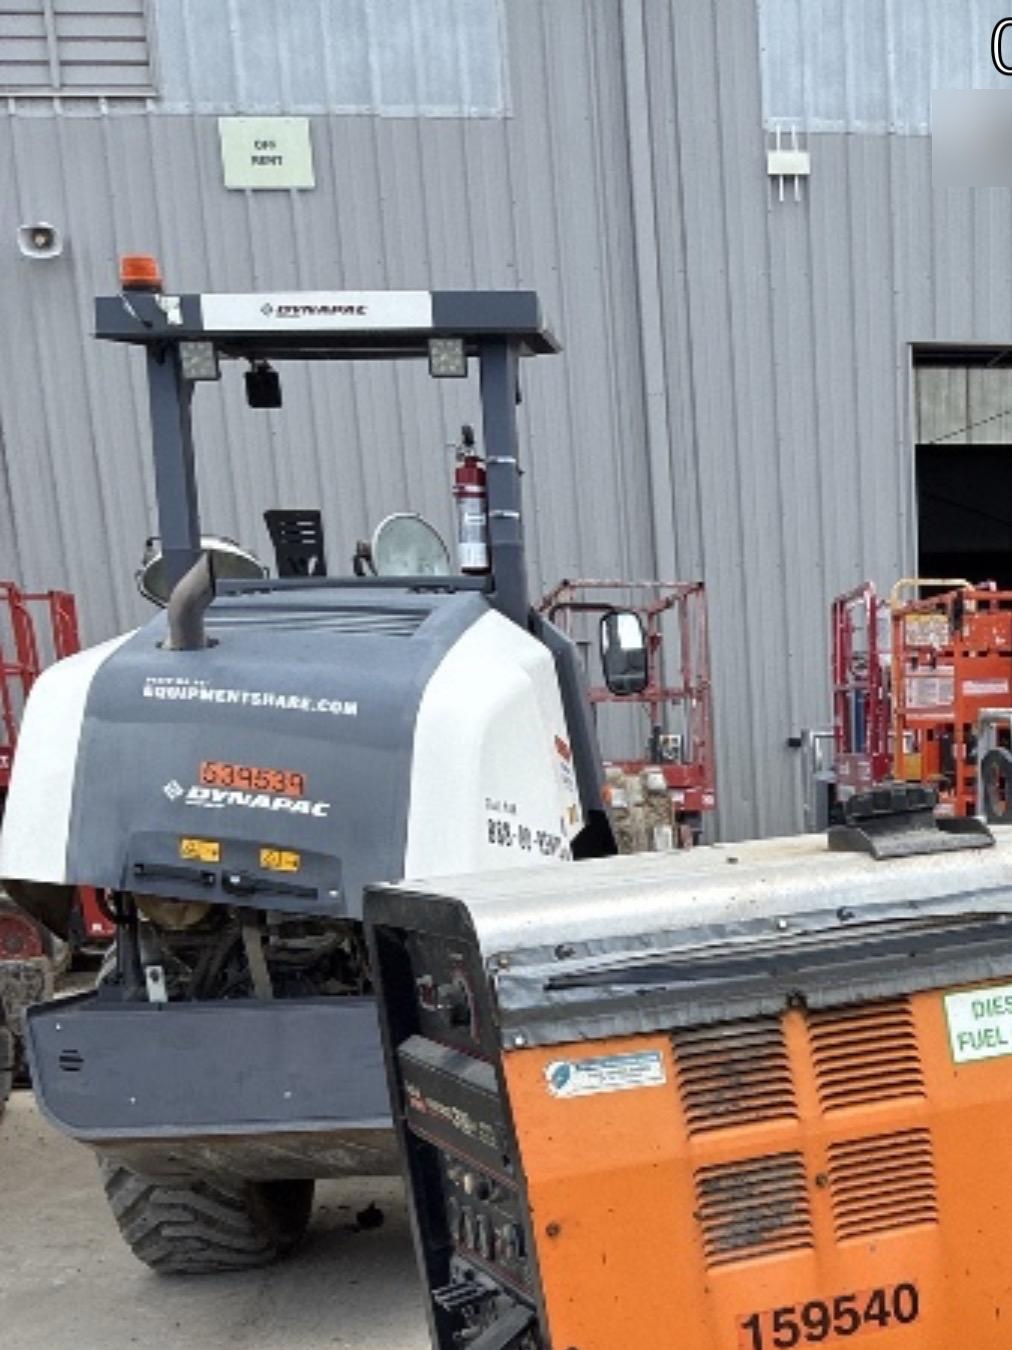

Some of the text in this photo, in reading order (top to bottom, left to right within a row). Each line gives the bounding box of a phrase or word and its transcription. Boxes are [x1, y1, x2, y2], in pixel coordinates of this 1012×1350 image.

[251, 155, 283, 166] RENT
[278, 304, 368, 316] DYNAPAC
[186, 786, 331, 818] DYNAPAC
[956, 1025, 1009, 1052] FUEL
